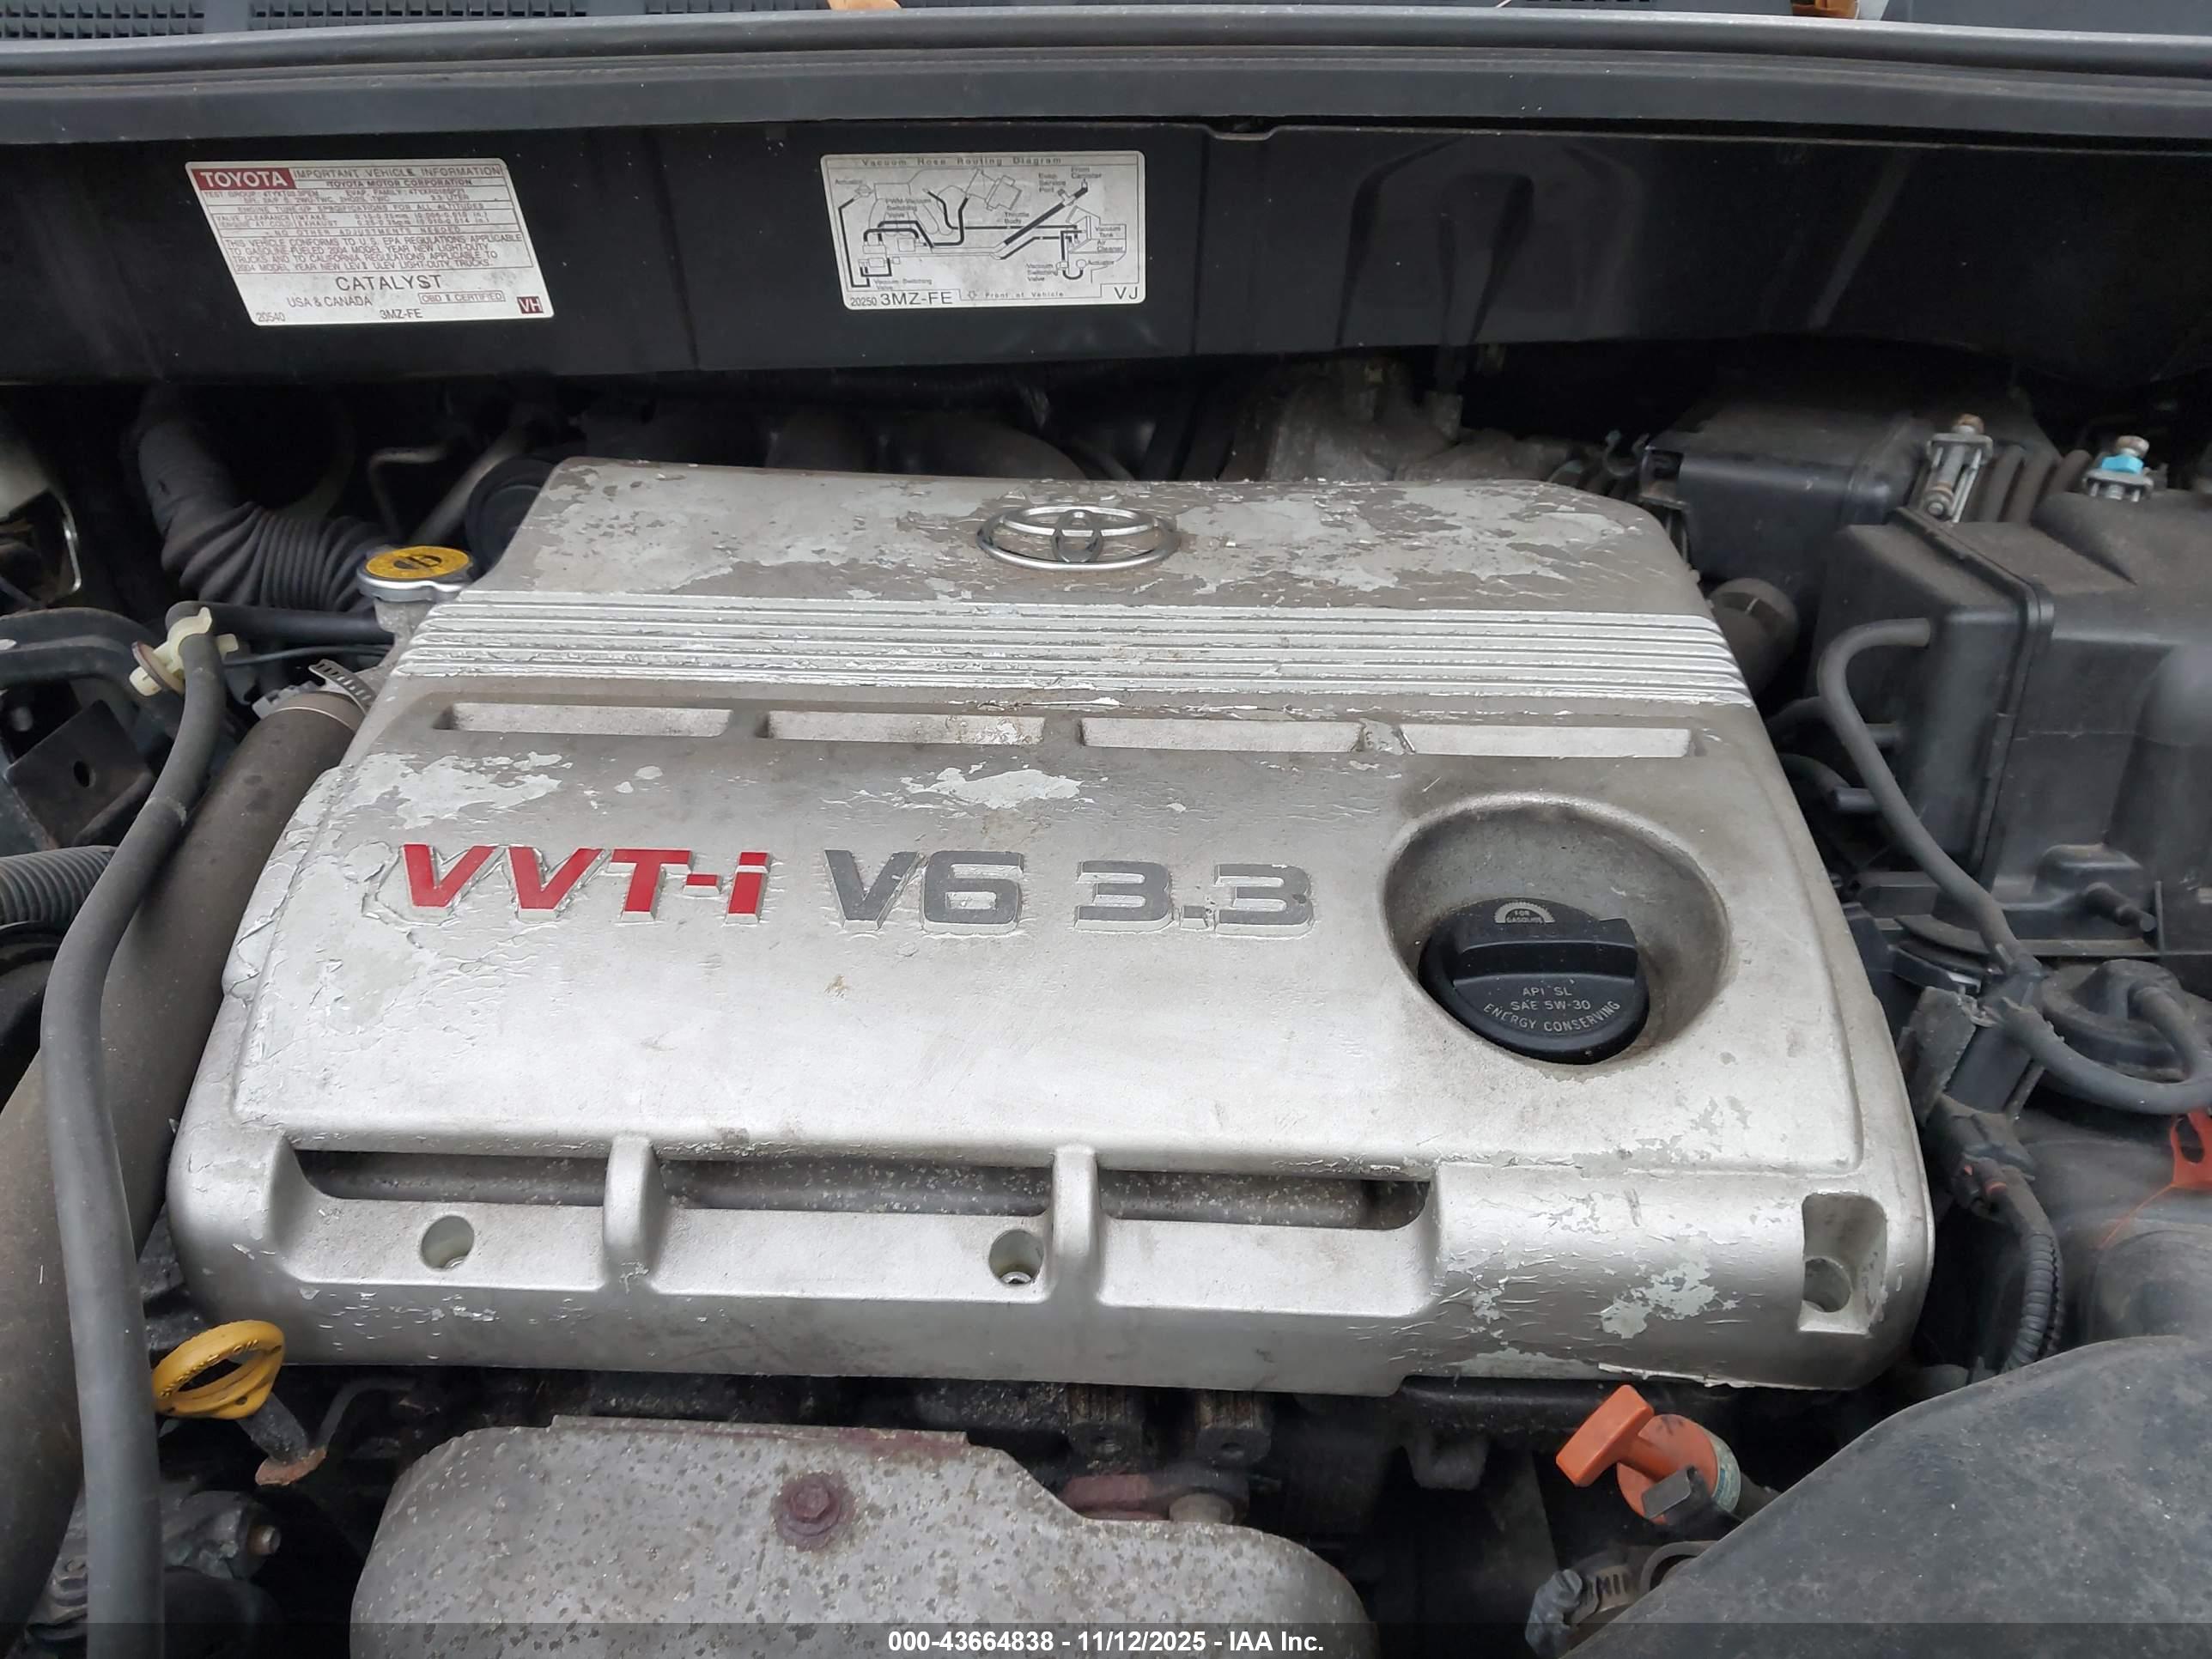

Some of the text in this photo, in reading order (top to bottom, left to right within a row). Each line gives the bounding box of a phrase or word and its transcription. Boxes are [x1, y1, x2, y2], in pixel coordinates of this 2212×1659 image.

[861, 156, 1061, 167] Vacuum Hose Routing Diagram
[294, 166, 501, 179] IMPORTANT VEHICLE INFORMATION
[200, 172, 288, 187] TOYOTA
[248, 238, 287, 246] VEHICLE
[289, 238, 339, 246] CONFORMS
[343, 237, 356, 246] TO
[404, 235, 465, 245] REGULATIONS
[471, 234, 522, 242] APPLICABLE
[228, 247, 241, 256] TO
[386, 245, 410, 253] YEAR
[233, 255, 268, 264] TRUCKS
[293, 254, 306, 263] TO
[310, 253, 360, 262] CALIFORNIA
[364, 252, 425, 261] REGULATIONS
[430, 251, 481, 259] APPLICABLE
[485, 250, 498, 258] TO
[336, 275, 441, 291] CATALYST
[422, 294, 442, 302] OBD
[455, 292, 502, 301] CERTIFIED
[851, 291, 953, 307] 20250 3MZ-FE
[1114, 286, 1138, 300] VJ
[287, 295, 373, 307] USA & CANADA
[519, 299, 542, 313] VH
[256, 312, 286, 322] 20540
[380, 308, 423, 319] 3MZ-FE
[402, 842, 1314, 933] VVT-i V6 3.3
[1522, 987, 1572, 996] API SL
[1510, 1000, 1591, 1012] SAE 5W-30
[1483, 1000, 1621, 1032] ENERGY CONSERVING
